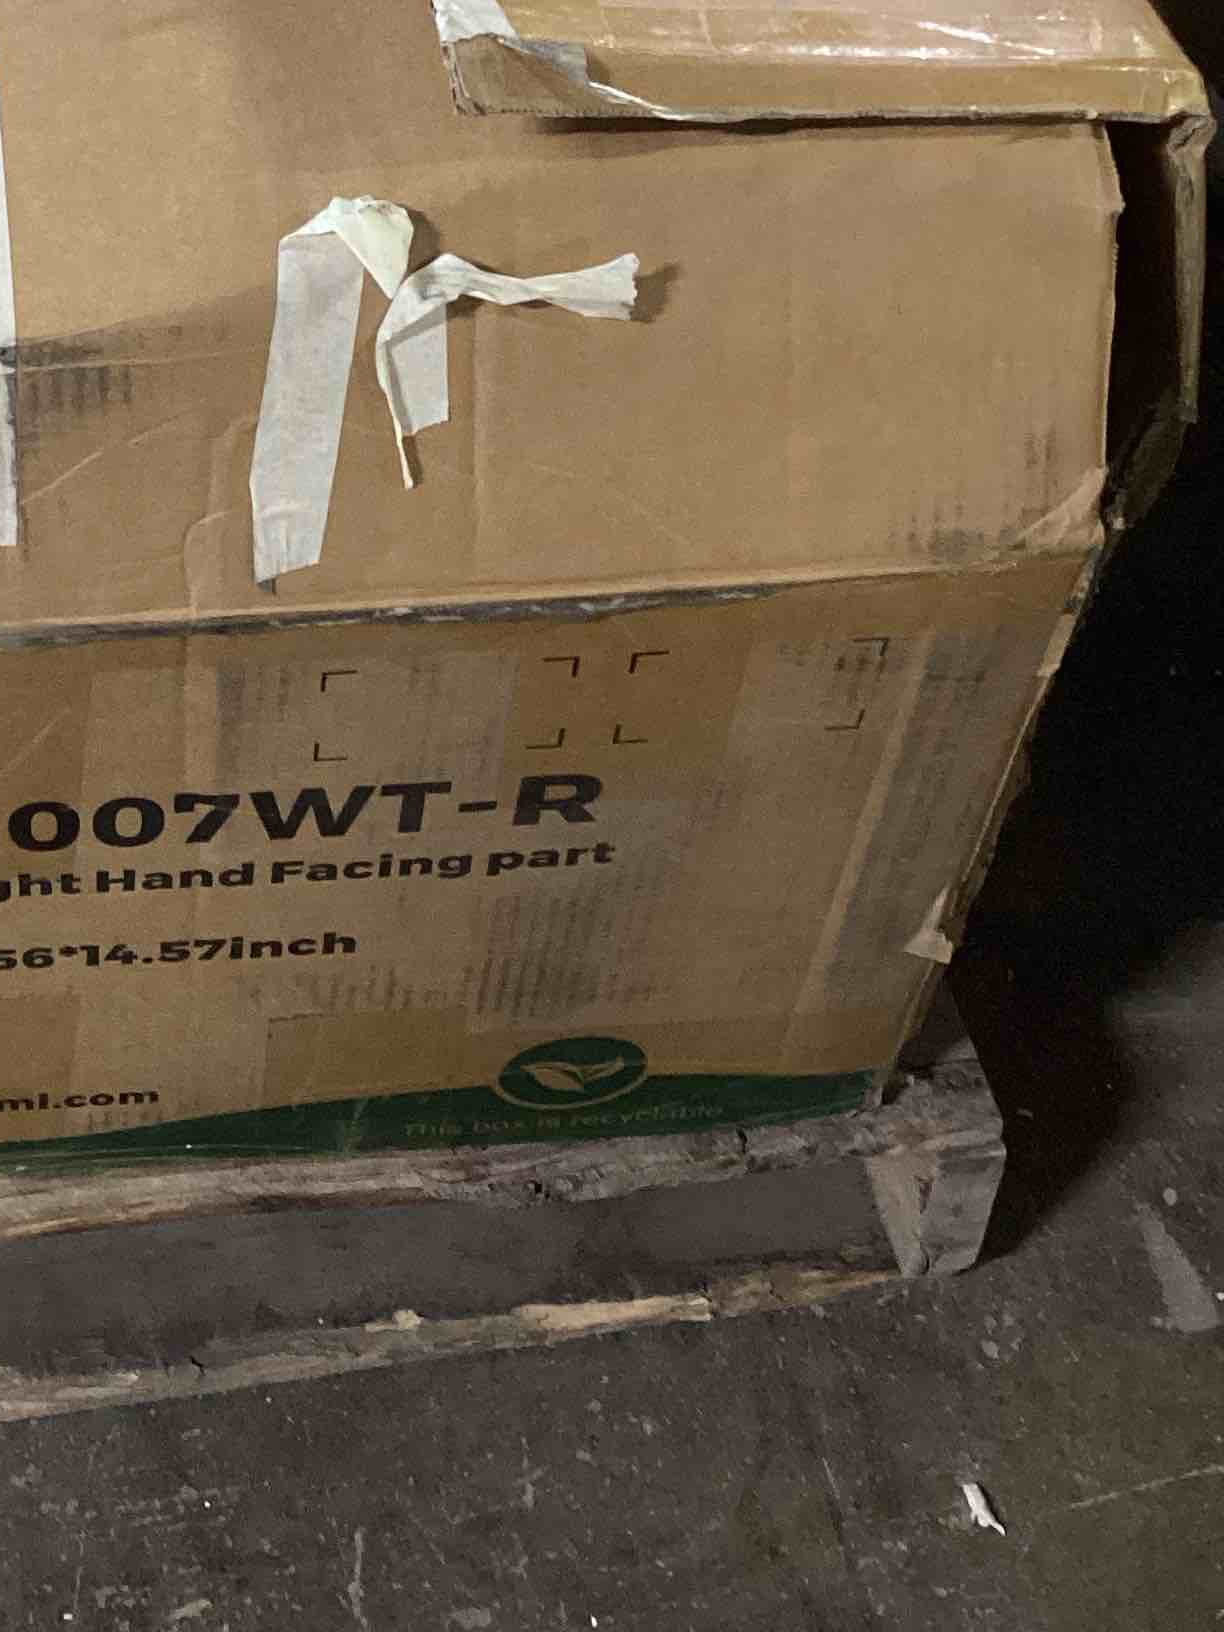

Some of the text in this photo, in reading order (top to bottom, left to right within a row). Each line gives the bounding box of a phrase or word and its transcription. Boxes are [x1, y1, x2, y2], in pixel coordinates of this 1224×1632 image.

[95, 858, 255, 894] Hand
[270, 850, 474, 888] Facing
[487, 840, 616, 877] part
